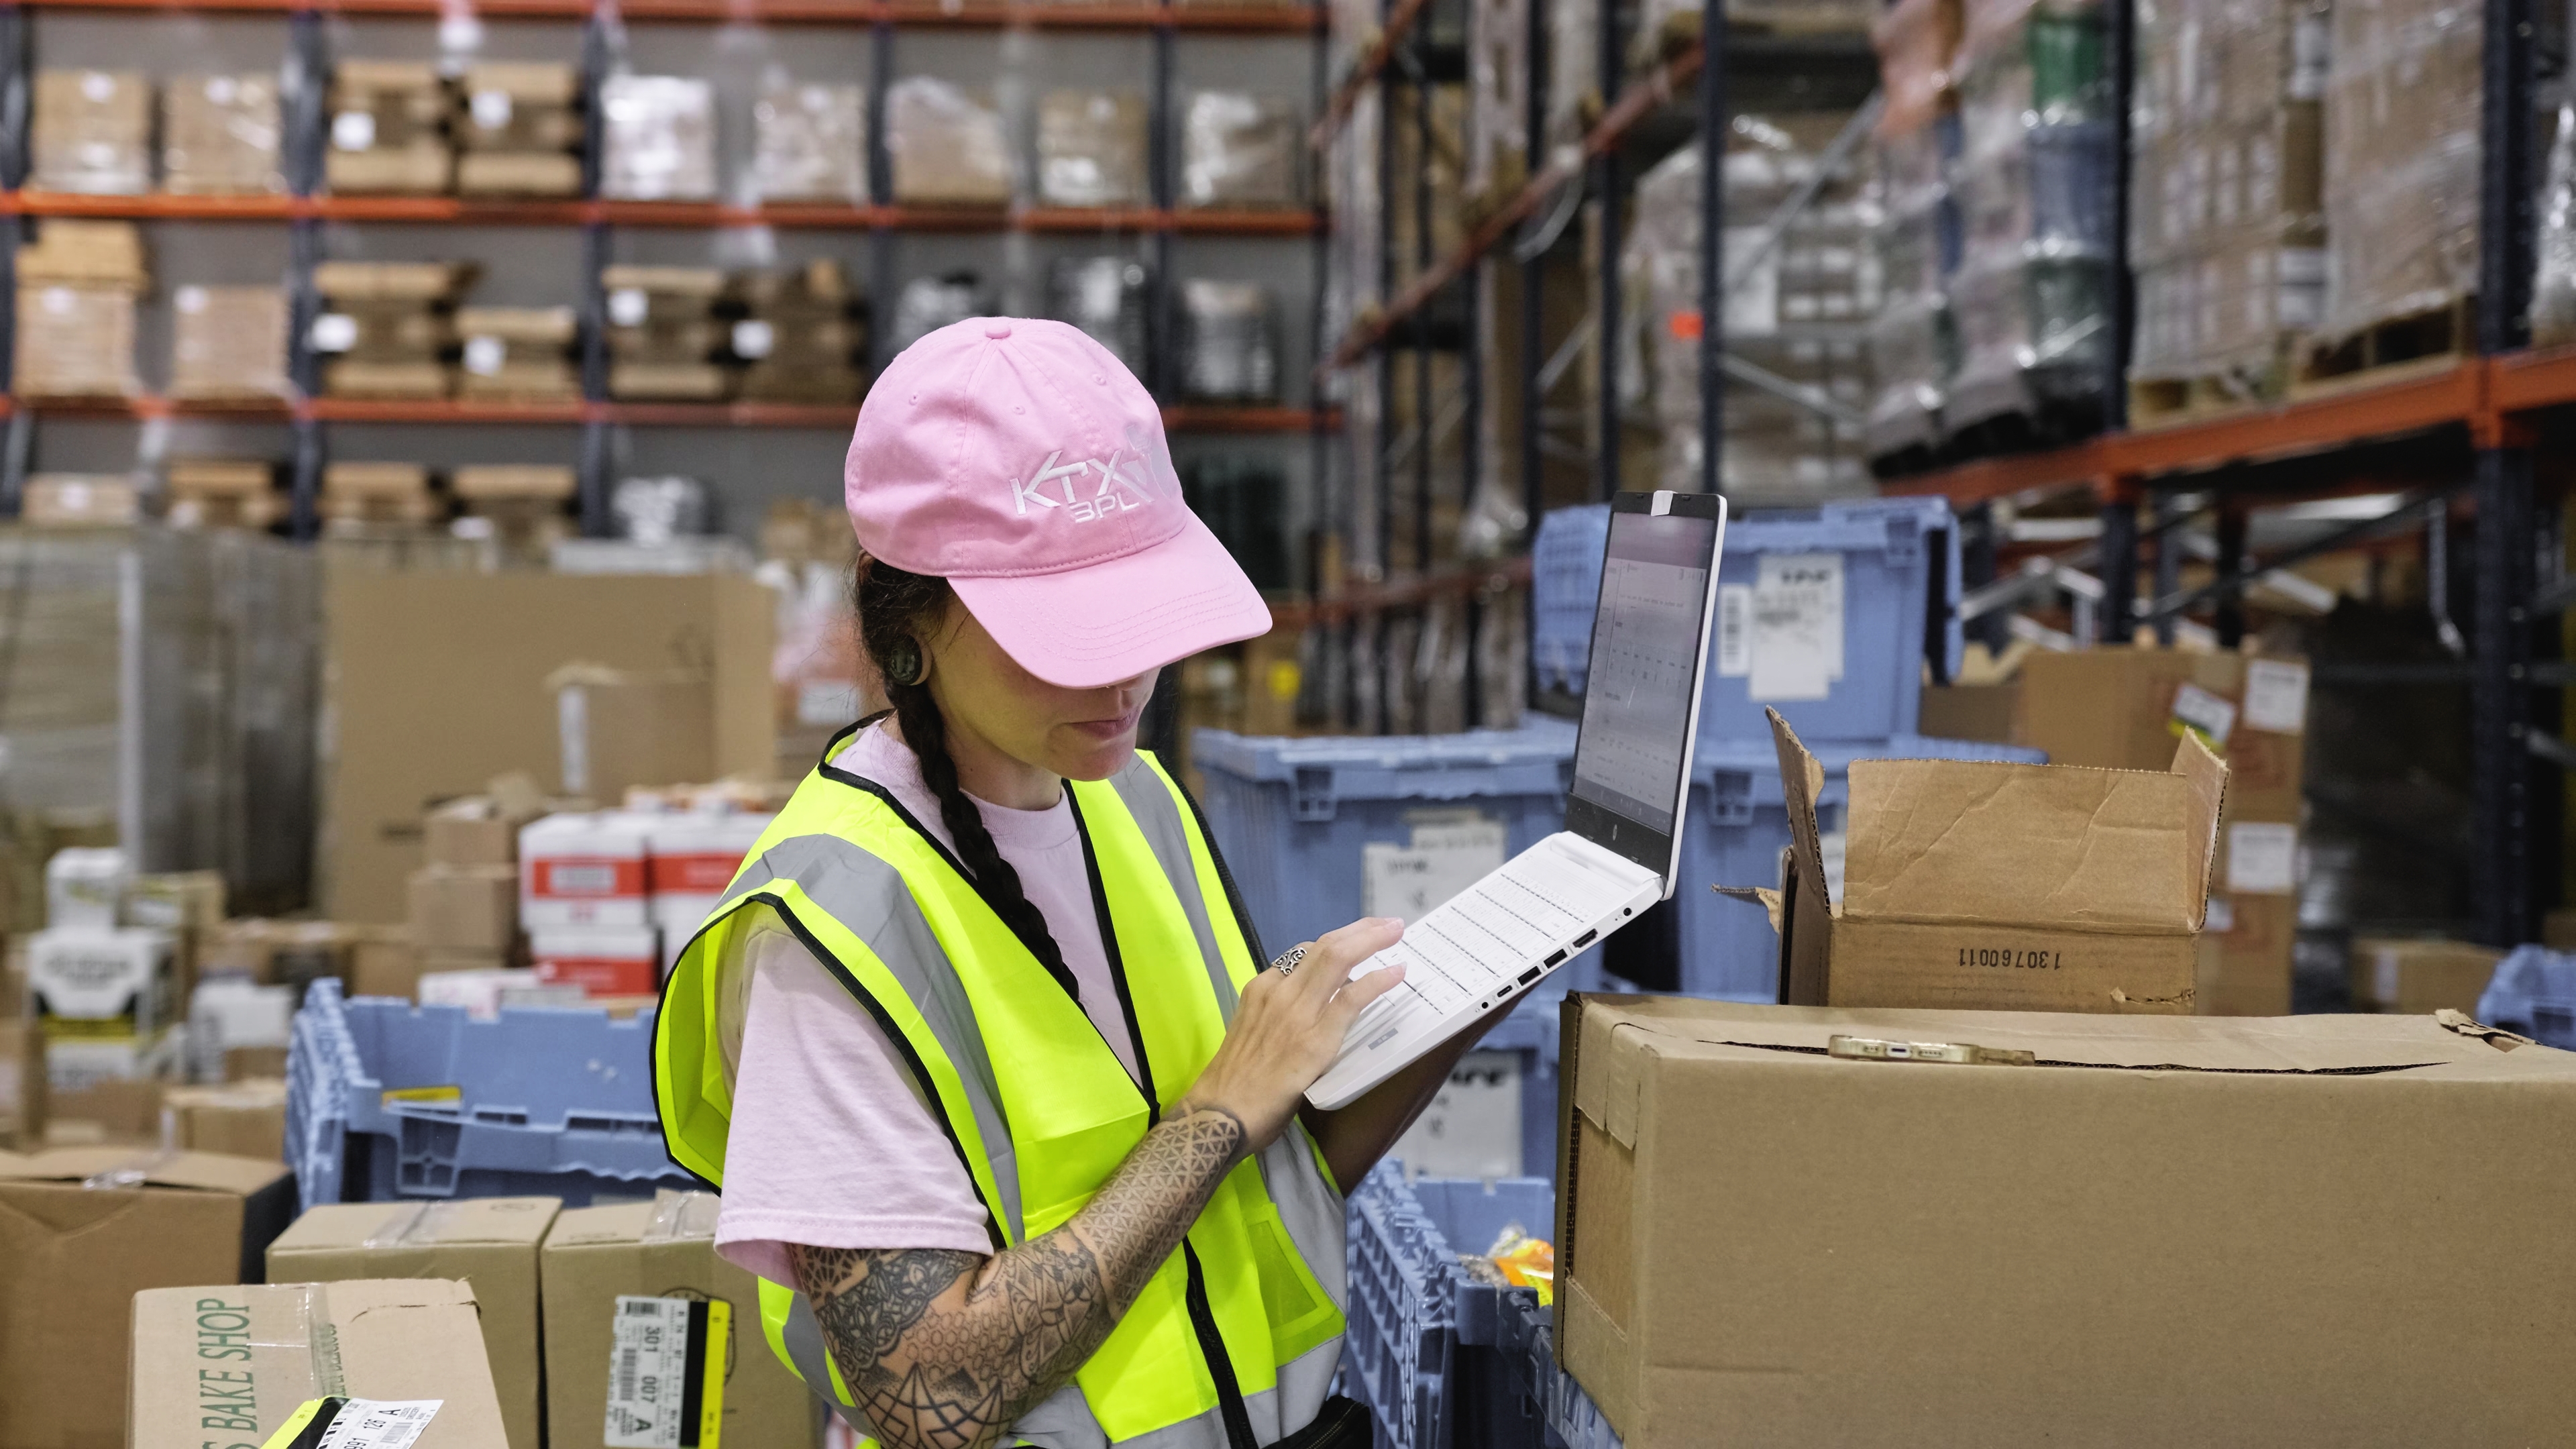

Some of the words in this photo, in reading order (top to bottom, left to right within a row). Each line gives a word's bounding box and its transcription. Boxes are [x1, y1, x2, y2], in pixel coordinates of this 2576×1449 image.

[1010, 449, 1155, 515] KTX
[1069, 492, 1140, 524] 3PL
[1960, 949, 2061, 970] 130760011
[196, 1298, 253, 1361] SHOP
[645, 1326, 660, 1352] 301
[199, 1369, 258, 1433] BAKE
[641, 1377, 657, 1403] 007
[362, 1418, 387, 1430] 126
[635, 1418, 652, 1432] A
